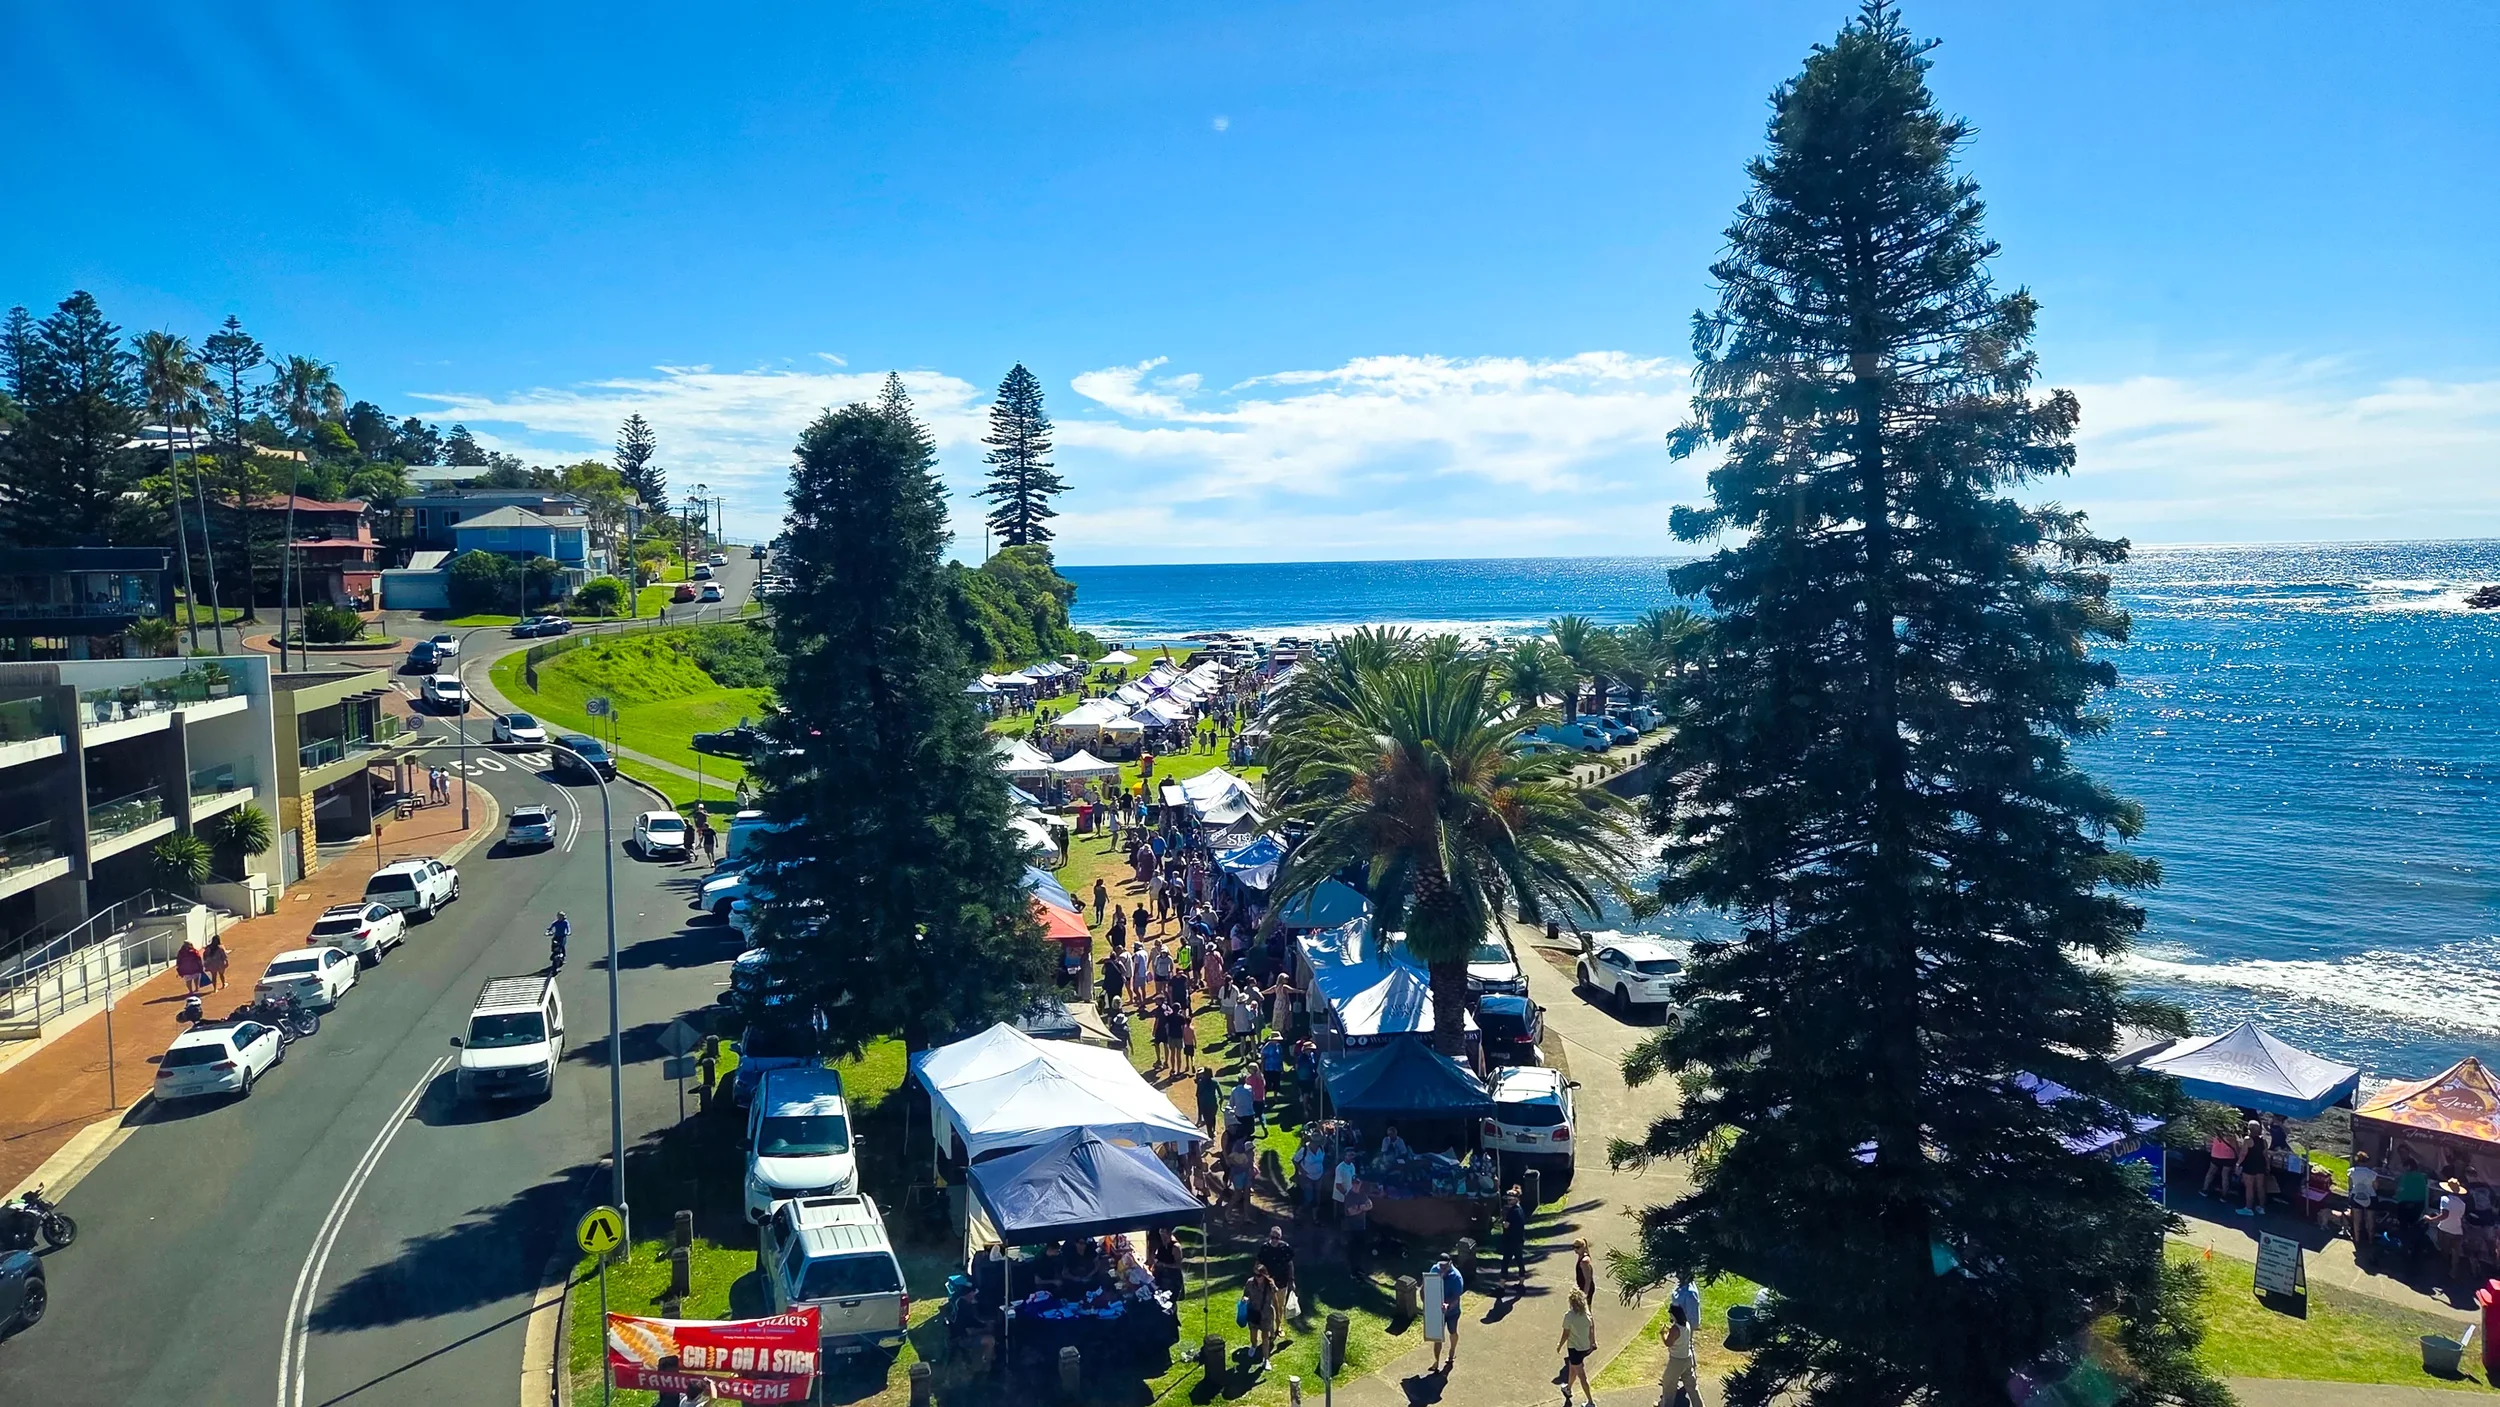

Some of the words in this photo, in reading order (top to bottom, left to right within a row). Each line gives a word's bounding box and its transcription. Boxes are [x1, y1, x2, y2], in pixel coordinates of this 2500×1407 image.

[448, 757, 507, 776] 50
[683, 1345, 728, 1370] CHIP
[732, 1347, 755, 1371] ON
[758, 1348, 769, 1371] A
[773, 1349, 815, 1374] STICK
[638, 1373, 690, 1389] FAMIL
[718, 1381, 790, 1399] OZLEME
